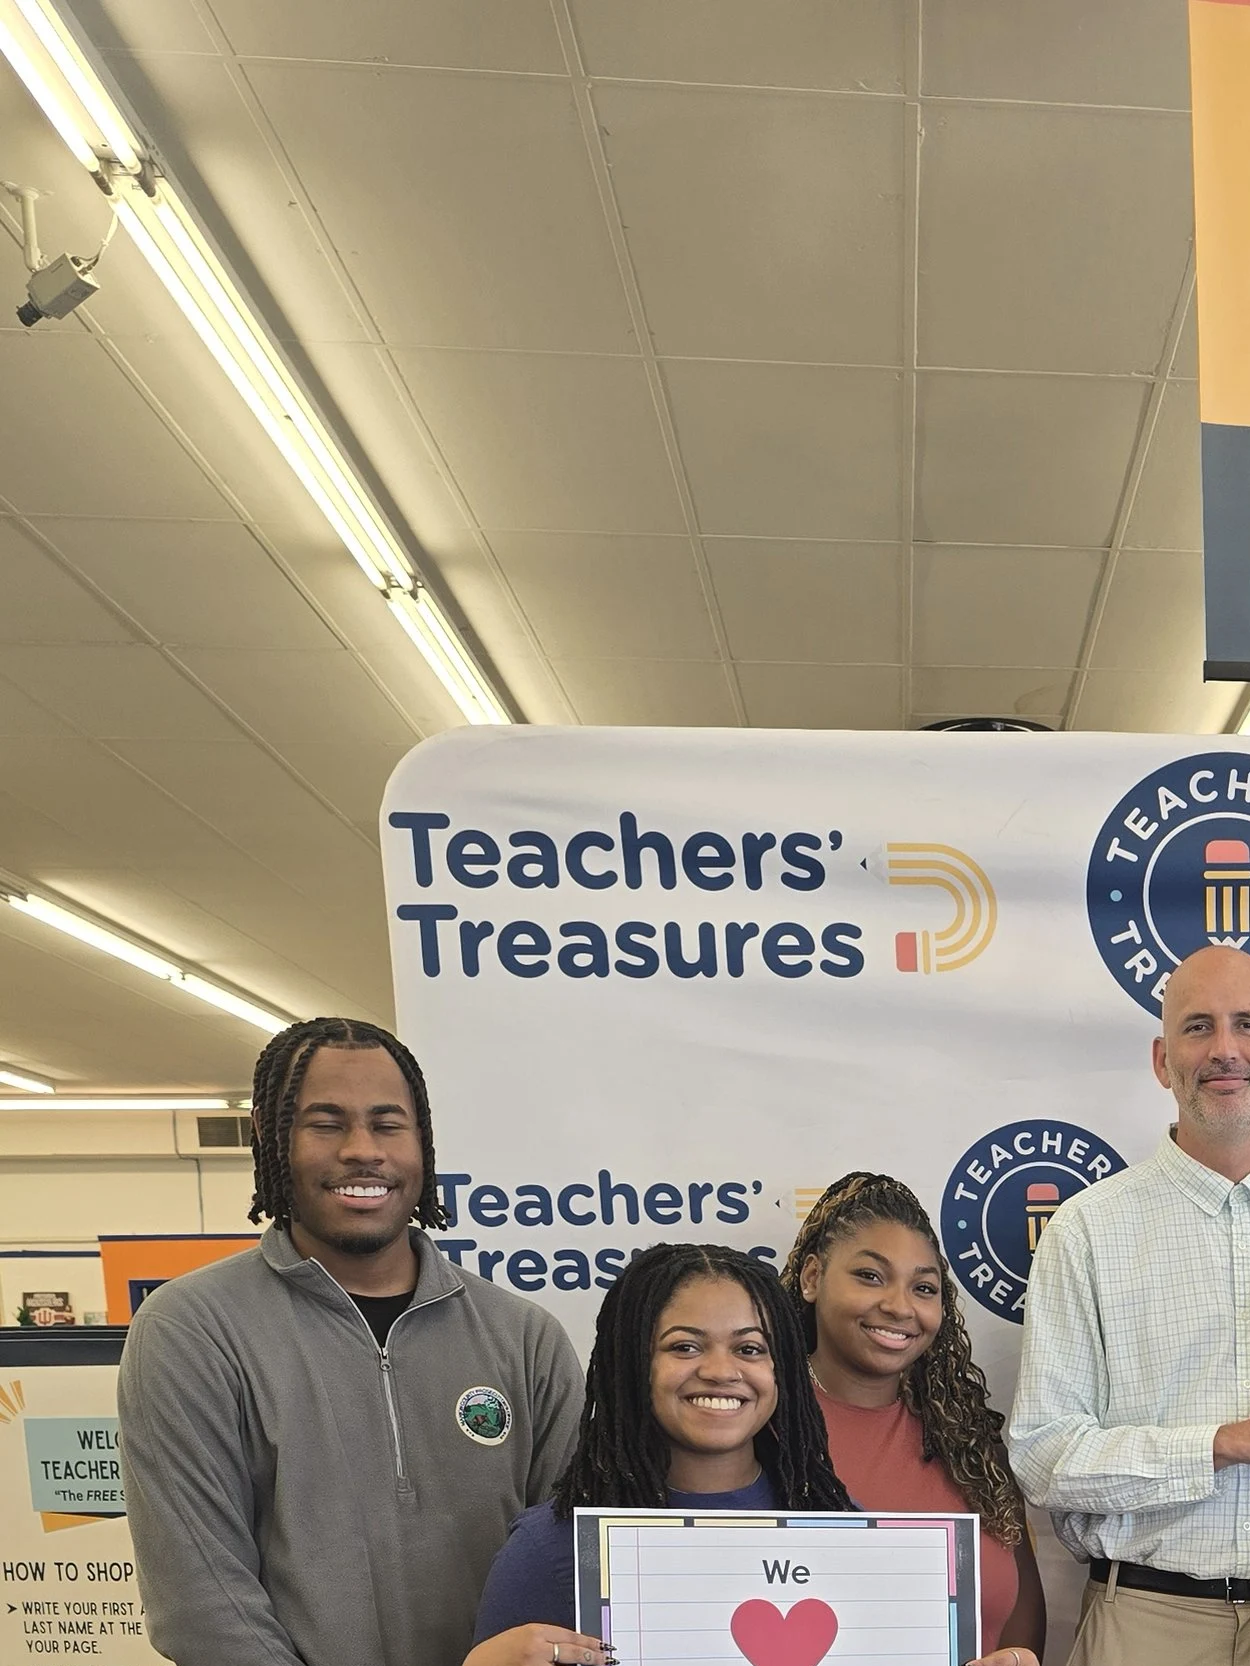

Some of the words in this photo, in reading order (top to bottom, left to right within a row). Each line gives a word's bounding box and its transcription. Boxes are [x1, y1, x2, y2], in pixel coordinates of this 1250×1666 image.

[388, 811, 843, 891] Teachers'
[396, 904, 865, 979] Treasures
[954, 1131, 1112, 1200] TEACHER
[87, 1490, 117, 1501] FREE
[3, 1562, 45, 1581] HOW
[54, 1562, 78, 1581] TO
[762, 1559, 811, 1584] We
[22, 1601, 60, 1615] WRITE
[64, 1602, 98, 1615] YOUR
[102, 1602, 134, 1616] FIRST
[23, 1621, 53, 1635] LAST
[58, 1621, 94, 1635] NAME
[100, 1621, 114, 1635] AT
[120, 1622, 142, 1635] THE
[26, 1640, 59, 1653] YOUR
[64, 1640, 102, 1654] PAGE.
